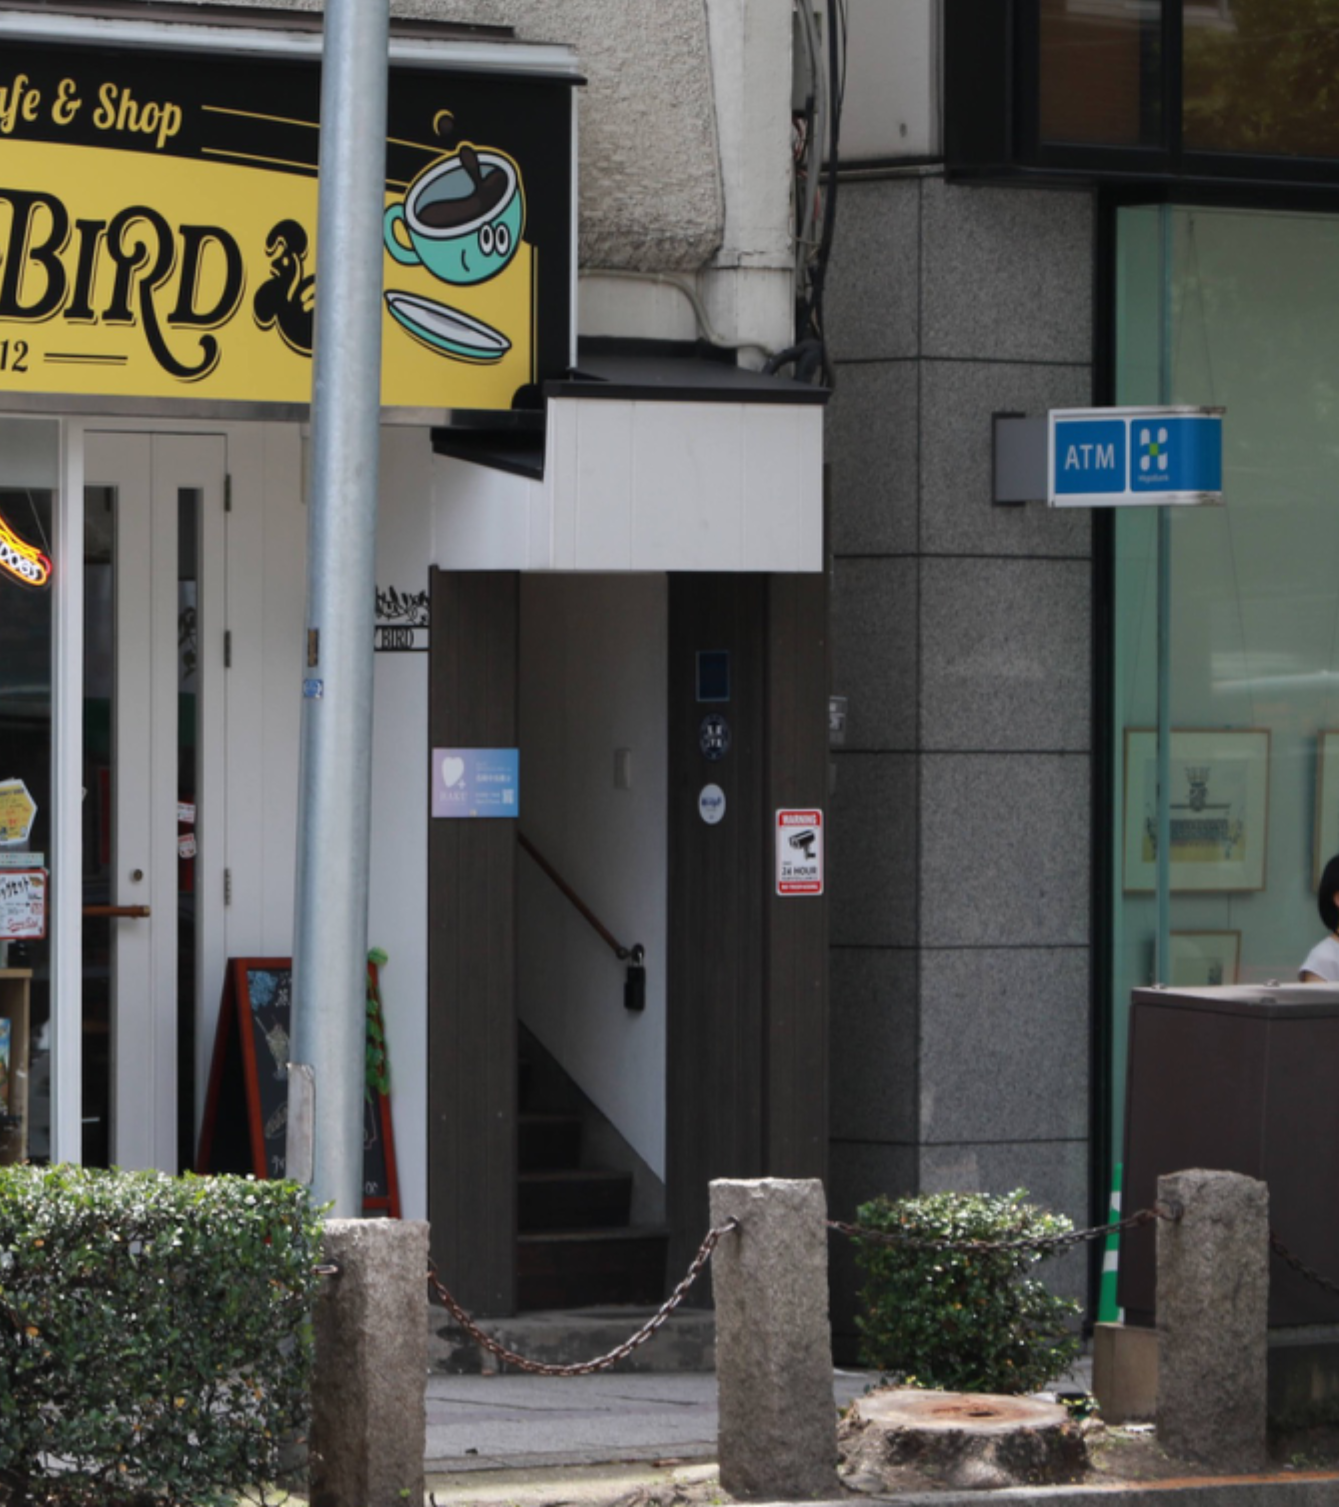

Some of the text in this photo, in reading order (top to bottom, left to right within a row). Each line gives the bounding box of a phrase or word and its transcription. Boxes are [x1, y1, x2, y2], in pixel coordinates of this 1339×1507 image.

[51, 80, 82, 125] &
[92, 82, 184, 148] Shop
[1065, 443, 1115, 470] ATM
[381, 628, 414, 650] BIRD
[793, 866, 817, 875] HOUR
